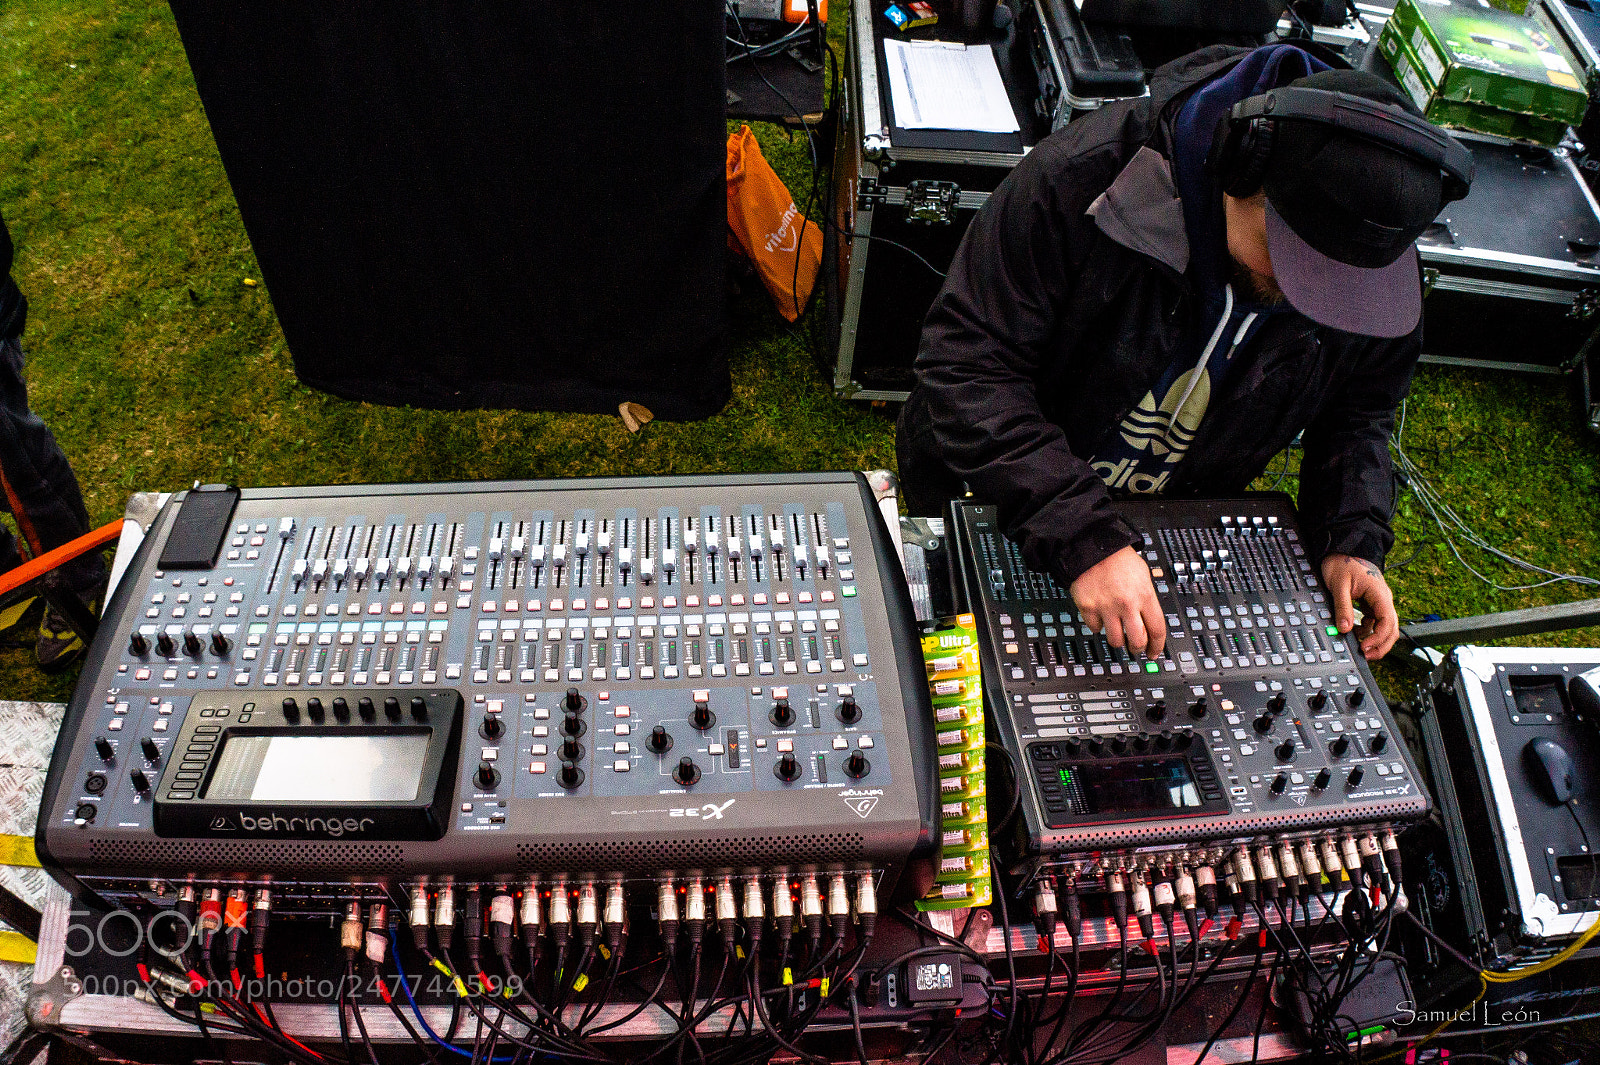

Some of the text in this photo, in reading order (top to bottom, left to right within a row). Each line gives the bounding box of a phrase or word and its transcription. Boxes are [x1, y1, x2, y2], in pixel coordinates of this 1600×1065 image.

[1087, 455, 1171, 494] did
[939, 635, 971, 648] Ultra
[837, 788, 884, 797] behringer
[239, 812, 375, 836] behringer
